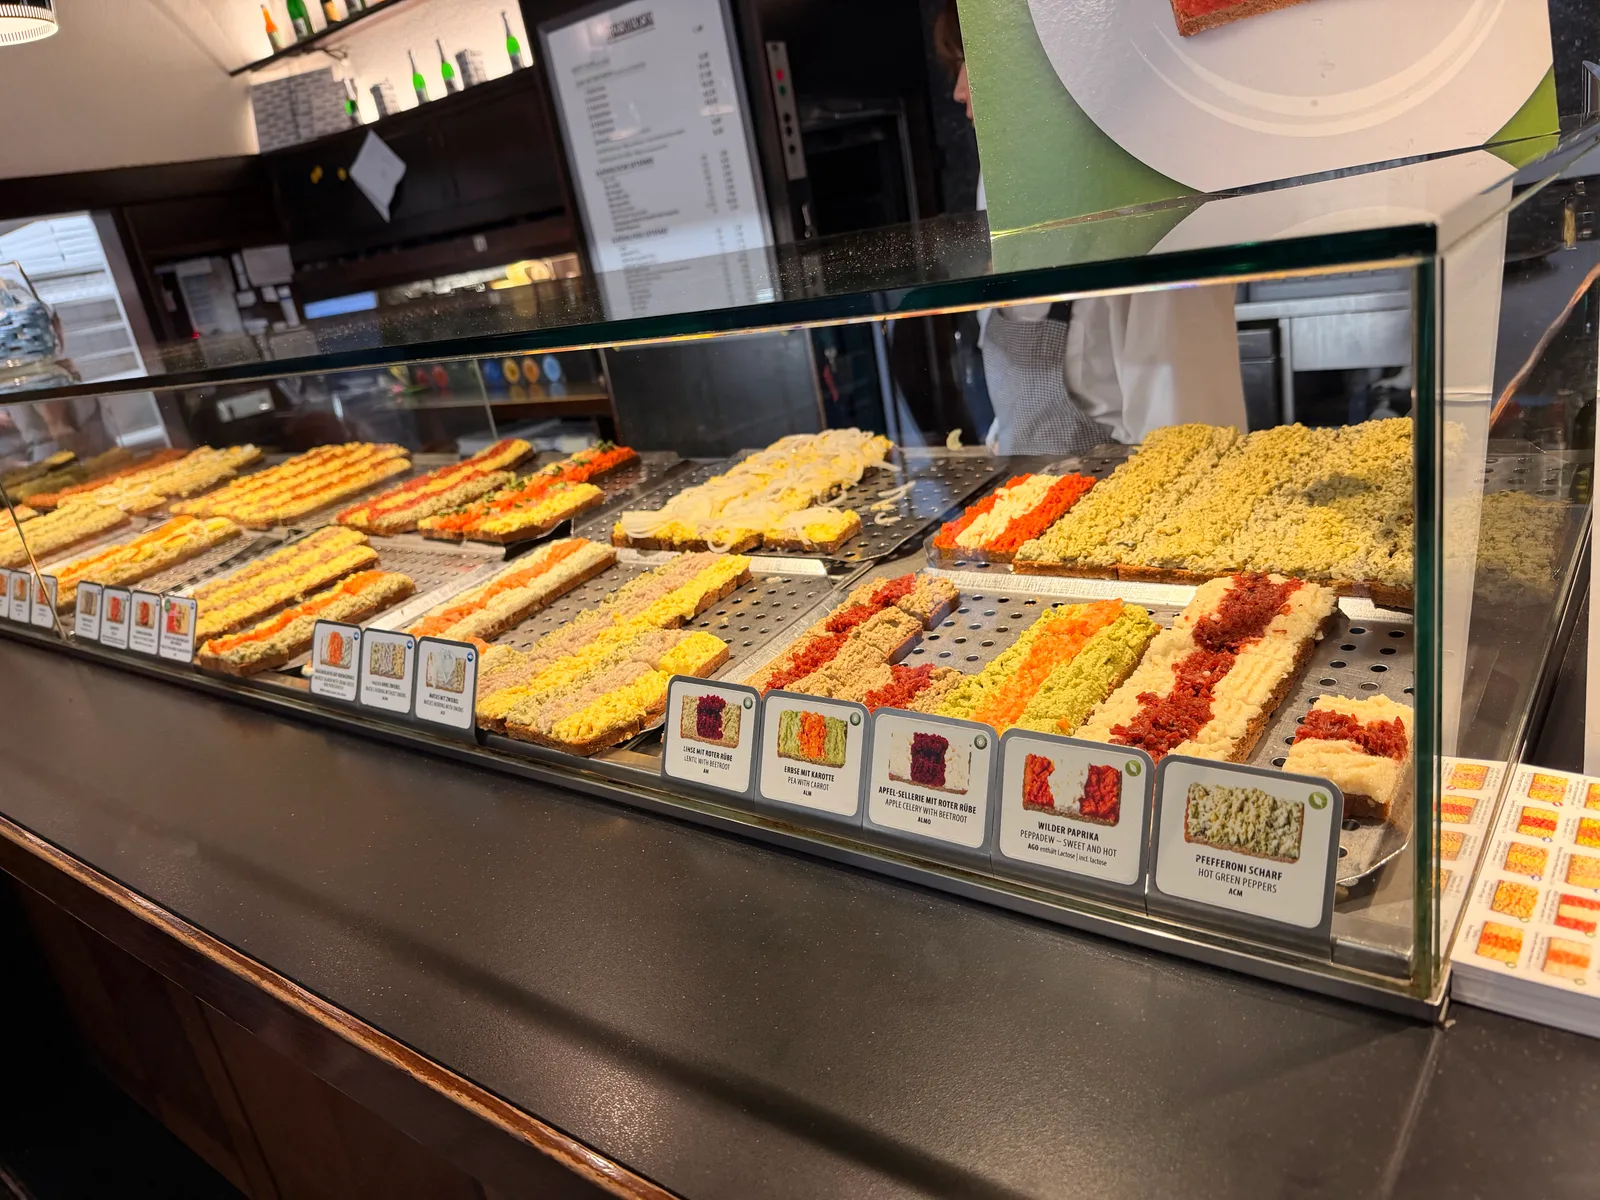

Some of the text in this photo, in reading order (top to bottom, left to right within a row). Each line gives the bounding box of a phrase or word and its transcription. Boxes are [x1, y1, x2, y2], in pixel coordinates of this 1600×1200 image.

[696, 748, 705, 756] MIT
[705, 750, 720, 759] ROTER
[698, 757, 709, 766] WITH
[709, 760, 731, 770] BEETROOT
[784, 766, 835, 782] ERBSE MIT KAROTTE
[787, 776, 829, 791] PEA WITH CARROT
[878, 786, 977, 814] APFEL-SELLERIE MIT ROTER RÜBE
[885, 798, 967, 824] APPLE CELERY WITH BEETROOT
[1038, 821, 1099, 841] WILDER PAPRIKA
[1020, 829, 1055, 844] PEPPADEW
[1063, 838, 1085, 851] SWEET
[1086, 844, 1102, 854] AND
[1102, 846, 1117, 858] HOT
[1027, 843, 1039, 851] AGO
[1057, 849, 1075, 860] Lactose
[1195, 854, 1283, 881] PFEFFERONI SCHARF
[1198, 867, 1277, 894] HOT GREEN PEPPERS
[1228, 887, 1243, 897] ACM
